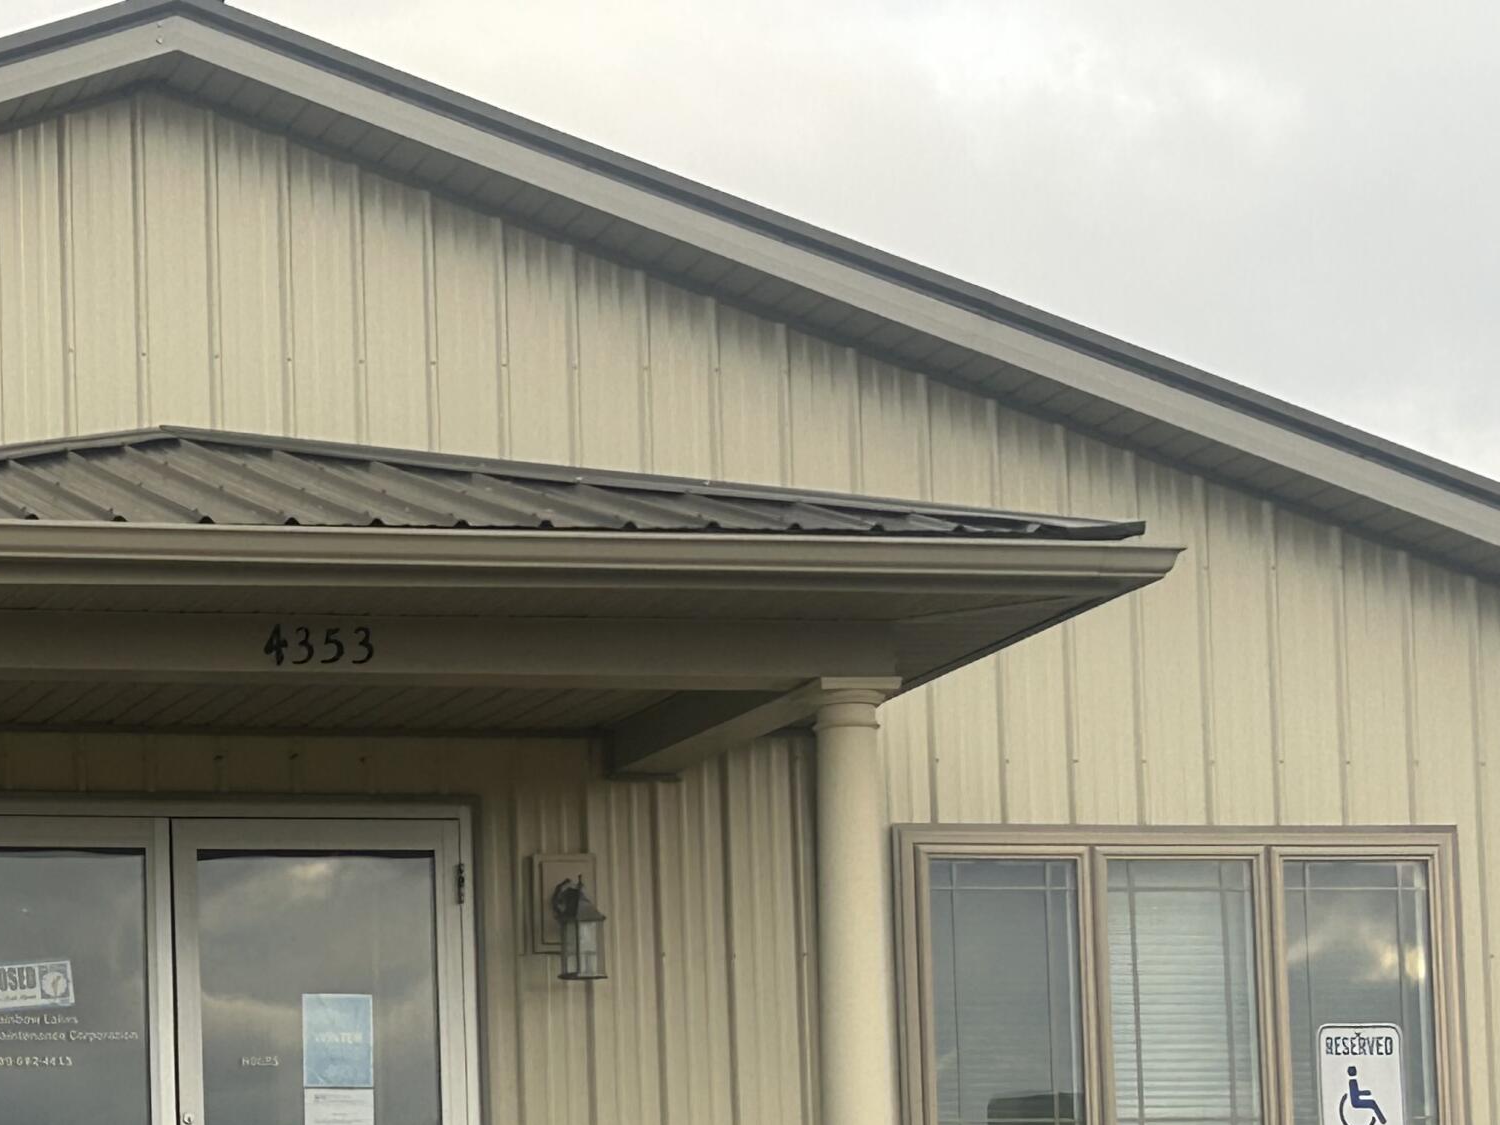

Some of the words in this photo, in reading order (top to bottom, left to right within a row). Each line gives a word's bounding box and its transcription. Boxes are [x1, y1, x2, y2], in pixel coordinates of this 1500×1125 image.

[264, 623, 374, 666] 4353
[69, 1030, 139, 1042] Corporation
[1325, 1036, 1394, 1056] RESERVED
